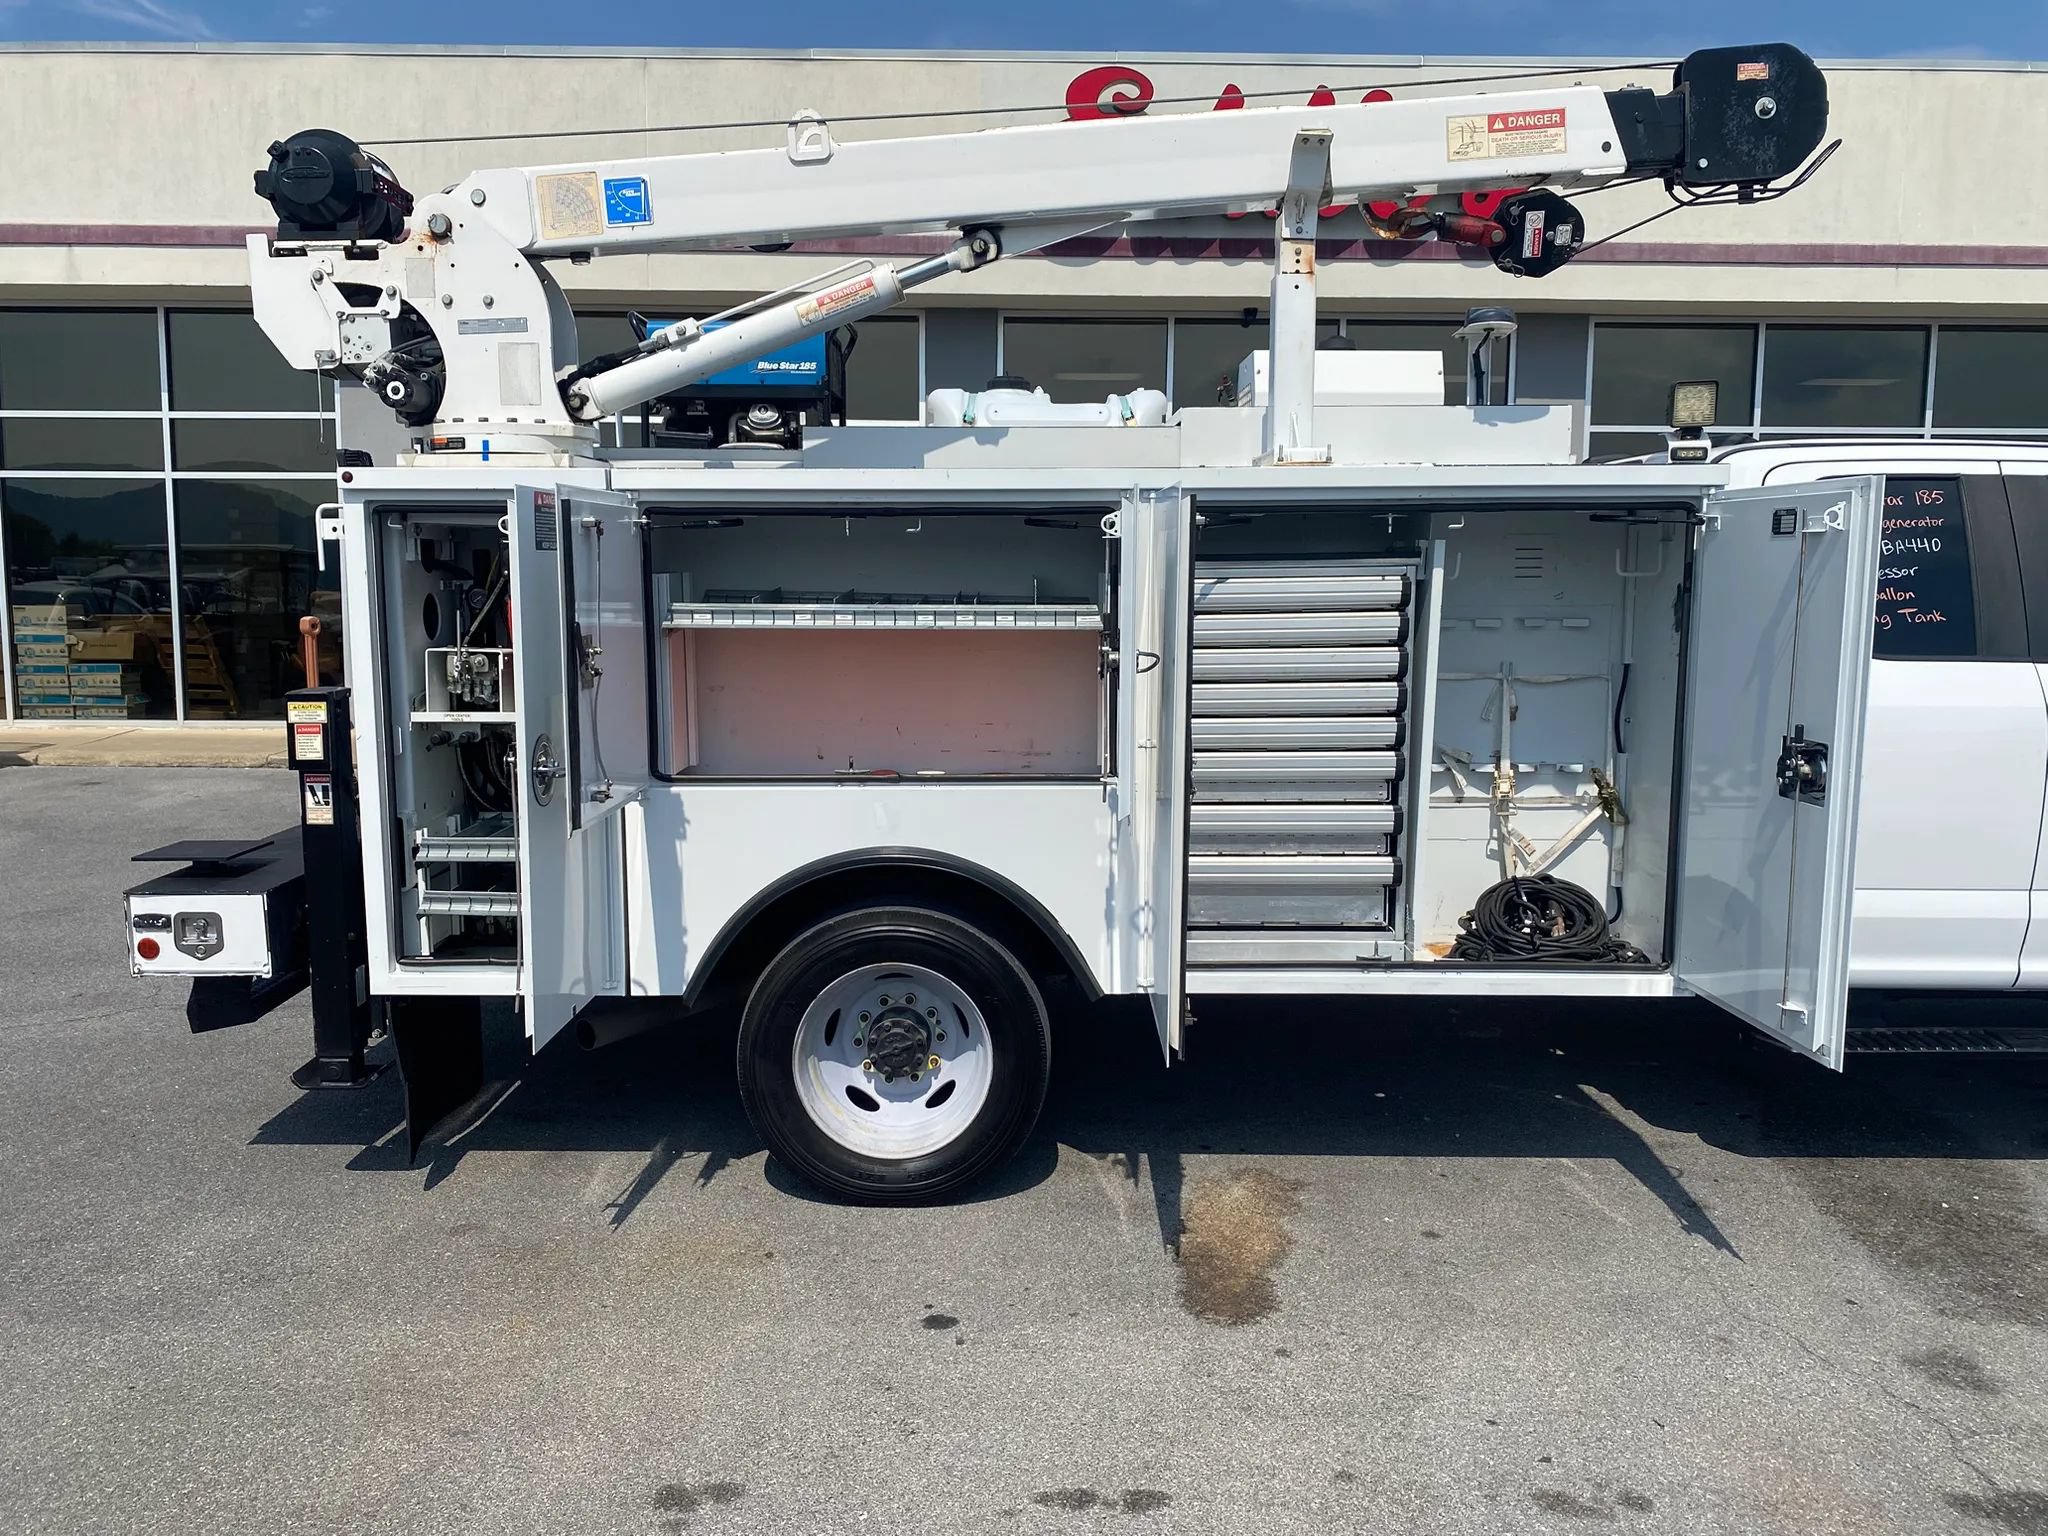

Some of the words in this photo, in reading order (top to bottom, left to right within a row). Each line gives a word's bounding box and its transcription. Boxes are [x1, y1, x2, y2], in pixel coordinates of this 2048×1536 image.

[1508, 113, 1561, 127] DANGER
[831, 281, 868, 300] DANGER
[757, 361, 778, 370] Blue
[779, 361, 799, 370] Star
[798, 362, 817, 370] 185
[1884, 494, 1904, 506] ar
[1915, 489, 1944, 506] 185
[1882, 516, 1944, 533] generator
[1881, 538, 1941, 556] BA440
[1897, 607, 1947, 623] Tank
